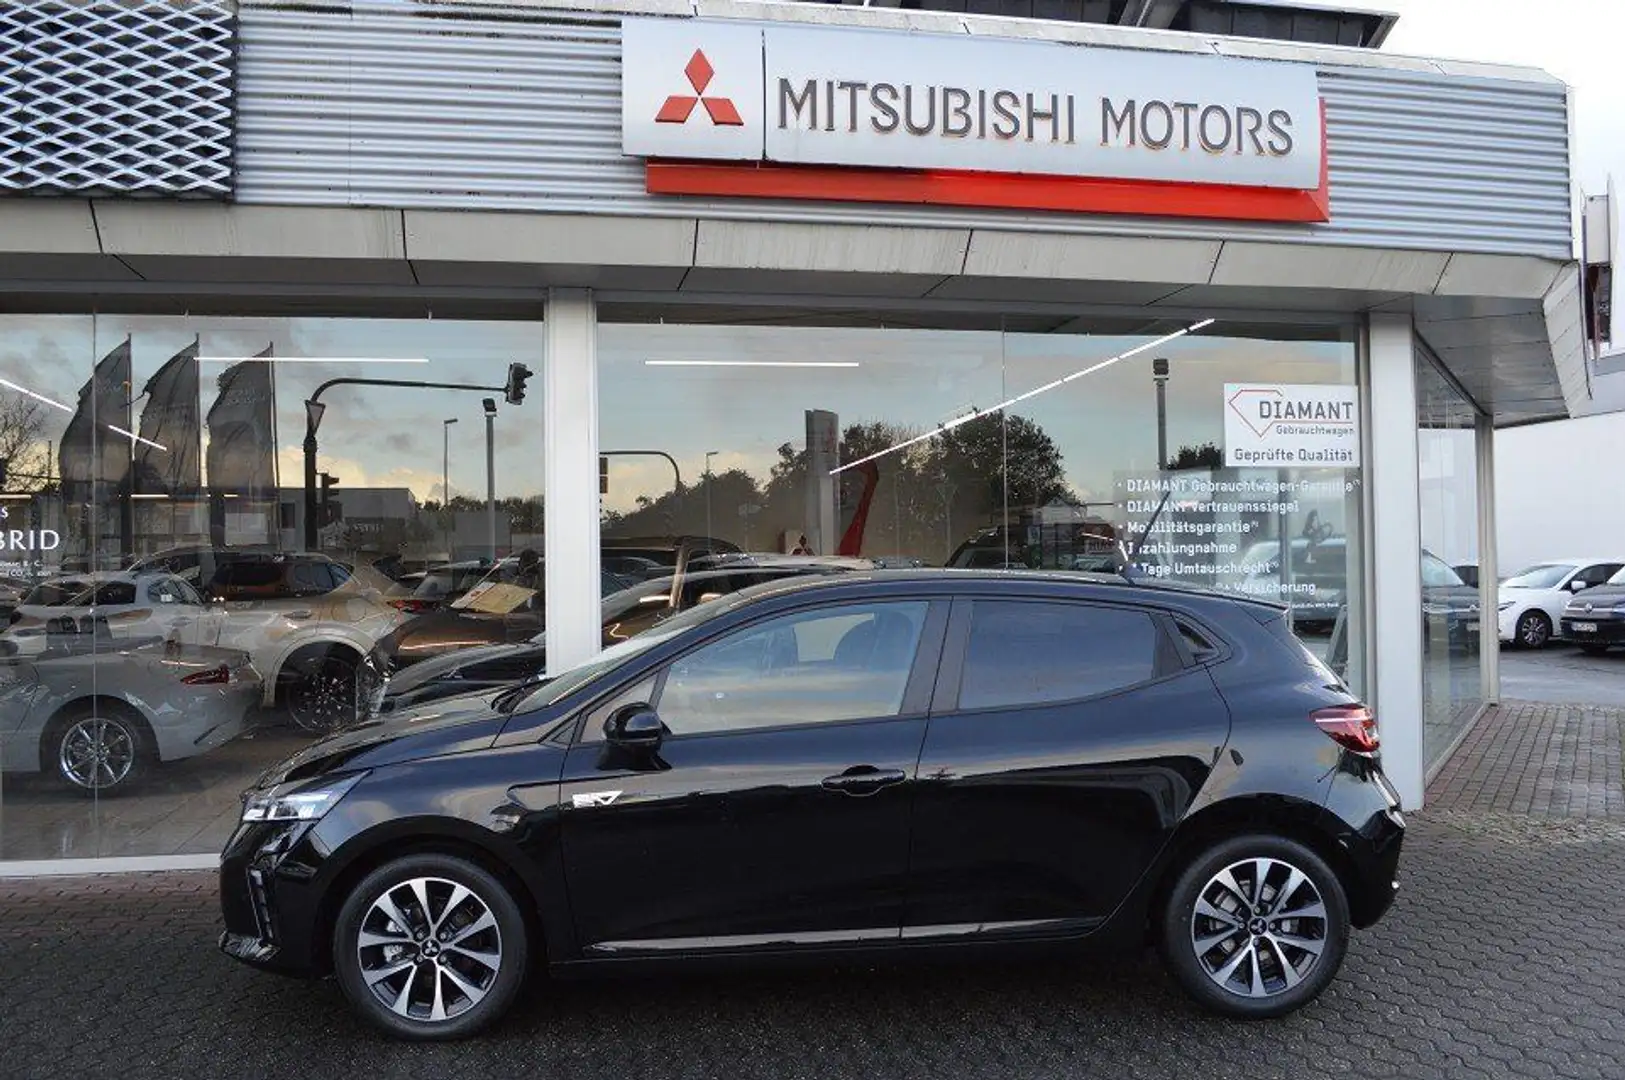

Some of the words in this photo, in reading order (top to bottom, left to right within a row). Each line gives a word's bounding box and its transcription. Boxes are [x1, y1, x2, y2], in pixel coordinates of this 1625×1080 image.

[777, 76, 1077, 145] MITSUBISHI
[1099, 96, 1293, 156] MOTORS
[1259, 401, 1353, 419] DIAMANT
[1276, 425, 1354, 437] Gebrauchtwagen
[1234, 448, 1294, 462] Geprüfte
[1298, 448, 1353, 461] Qualität
[1127, 479, 1188, 493] DIAMANT
[1191, 479, 1354, 495] Gebrauchtwagen-Ge
[1127, 500, 1187, 513] DIAMANT
[1191, 499, 1300, 515] Vertrauenssiegel
[1141, 562, 1171, 577] Tage
